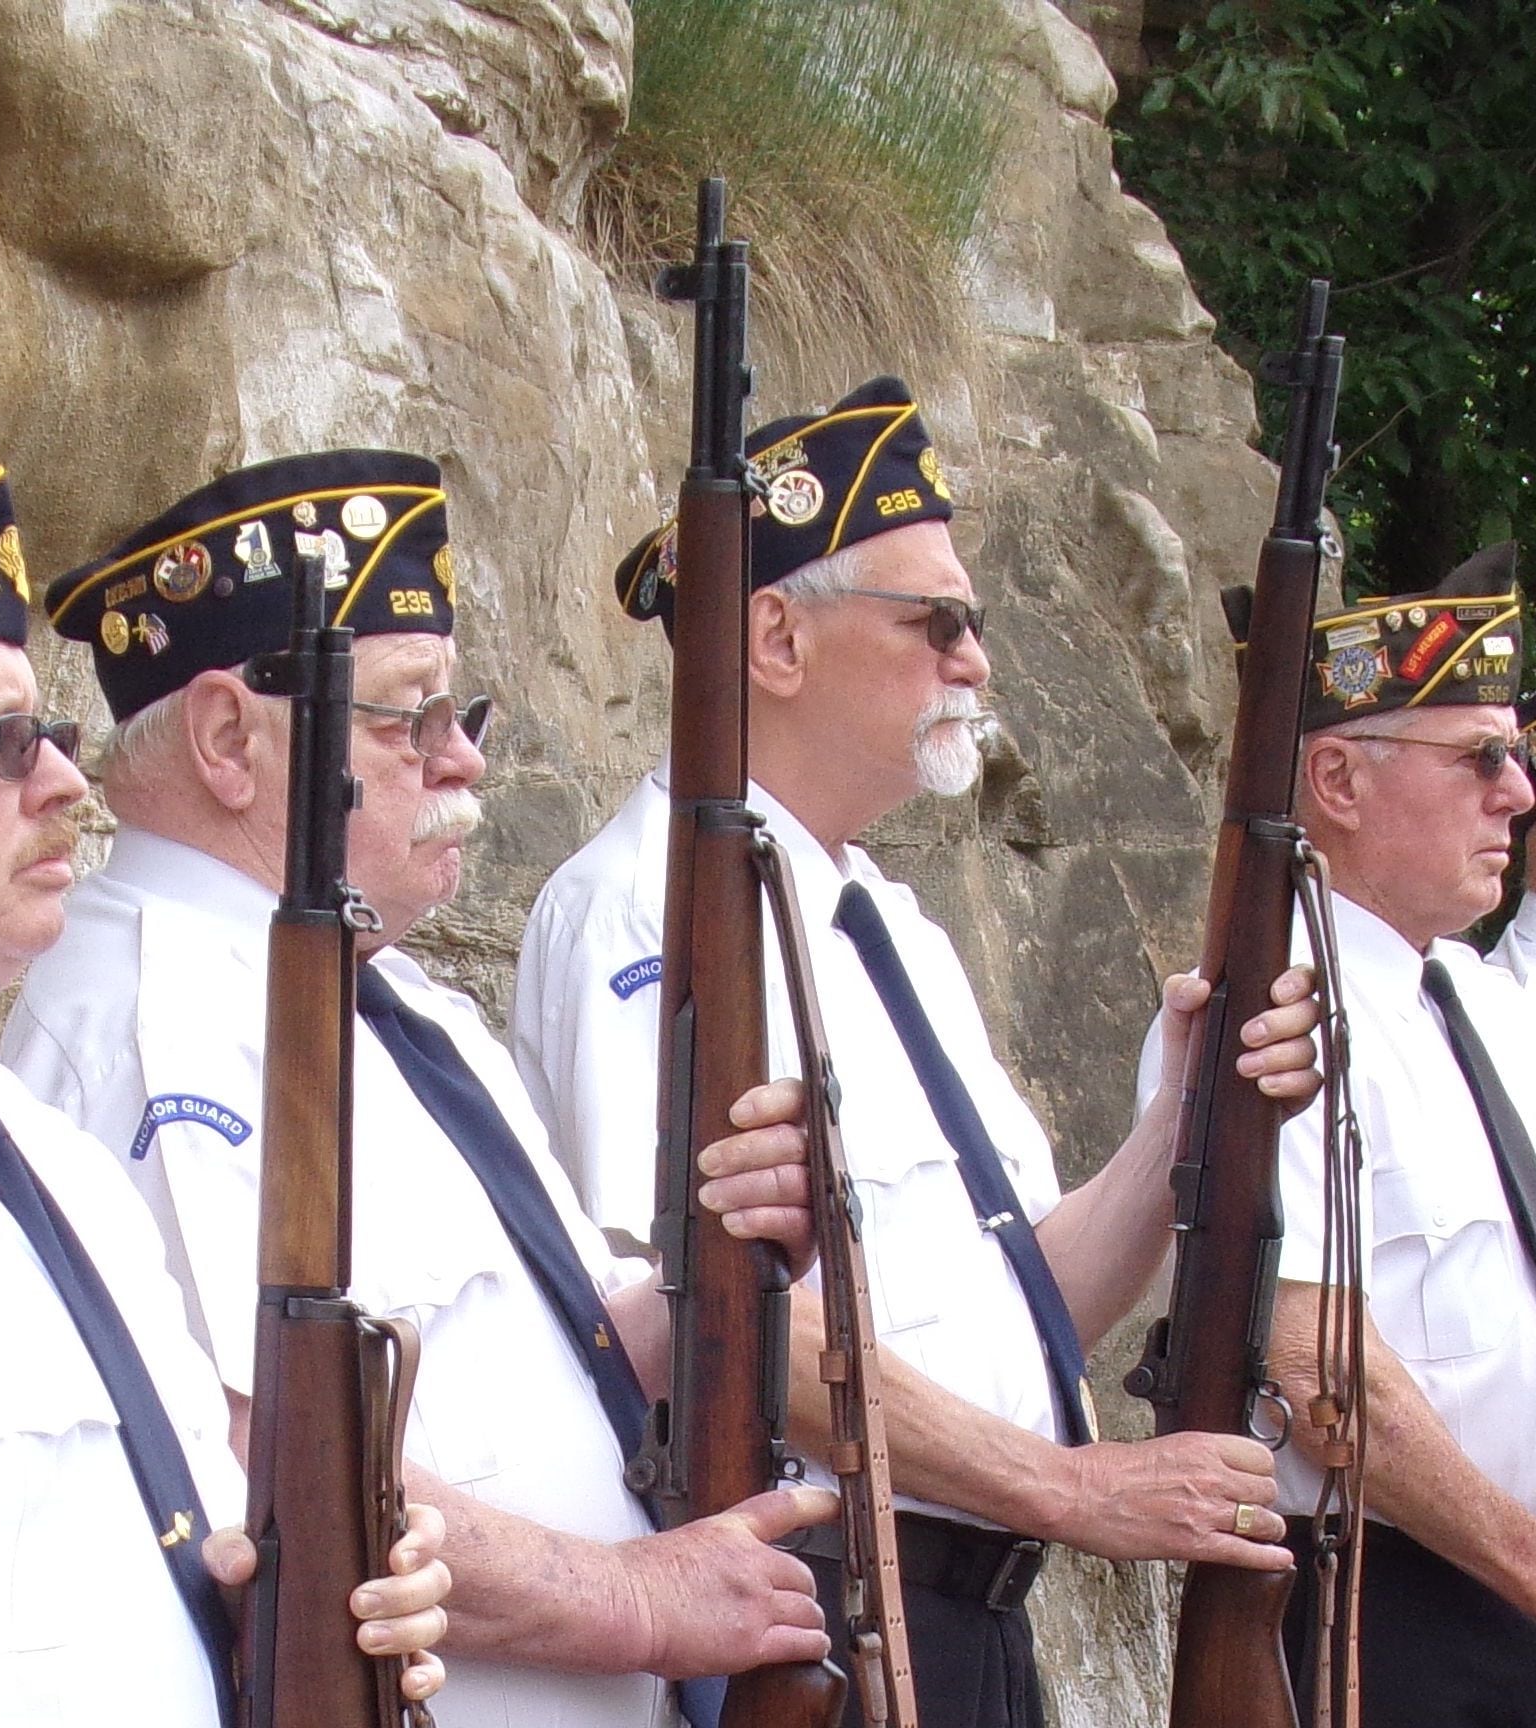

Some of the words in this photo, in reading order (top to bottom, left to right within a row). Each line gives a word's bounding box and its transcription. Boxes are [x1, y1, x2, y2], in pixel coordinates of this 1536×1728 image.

[876, 489, 922, 515] 235
[389, 589, 433, 616] 235
[1473, 657, 1510, 676] VFW
[617, 961, 661, 991] HONO
[135, 1100, 177, 1151] HONOR
[181, 1099, 243, 1135] GUARD
